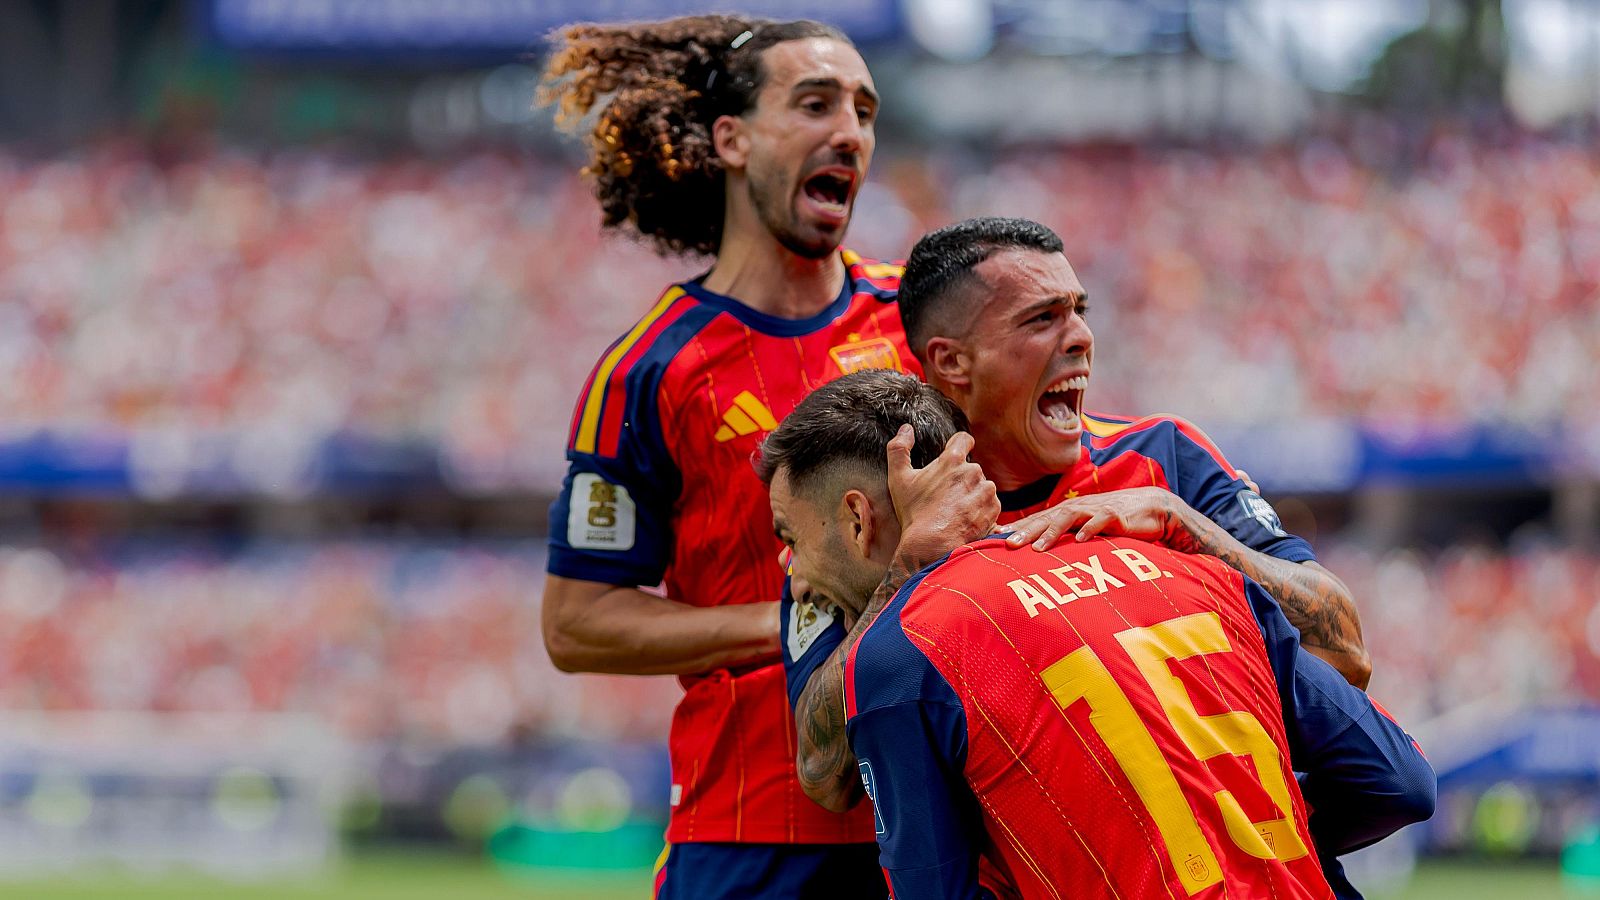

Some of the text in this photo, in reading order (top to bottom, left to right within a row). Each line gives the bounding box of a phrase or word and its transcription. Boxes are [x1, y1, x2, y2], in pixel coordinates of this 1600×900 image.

[1007, 549, 1174, 618] ALEX B.
[1039, 611, 1309, 897] 15
